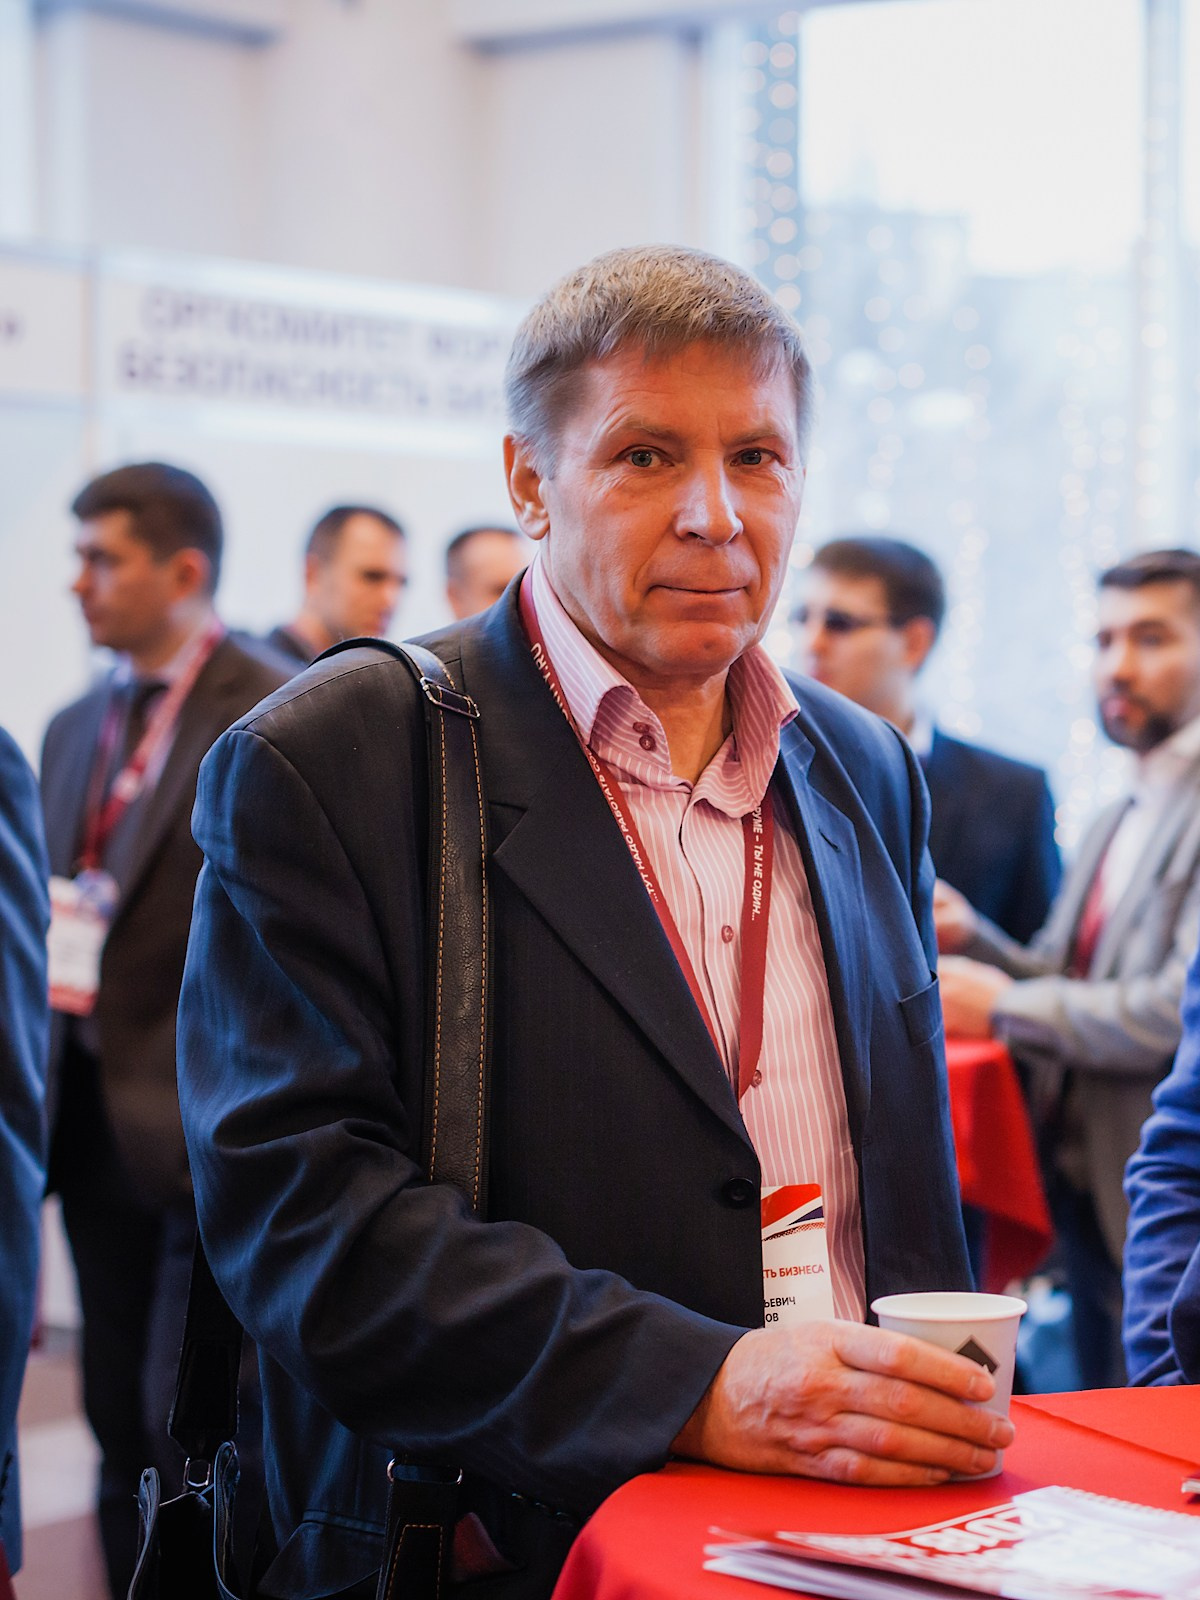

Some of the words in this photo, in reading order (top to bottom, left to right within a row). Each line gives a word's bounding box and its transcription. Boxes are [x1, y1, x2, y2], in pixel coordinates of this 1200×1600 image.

[599, 774, 629, 832] РАБОТАТЬ
[753, 806, 763, 834] РУМЕ
[625, 834, 645, 870] НАДО
[754, 844, 763, 861] ТЫ
[753, 863, 762, 879] НЕ
[779, 1264, 824, 1277] БИЗНЕСА
[764, 1296, 796, 1308] ЬЕВИЧ
[765, 1313, 779, 1323] ОВ
